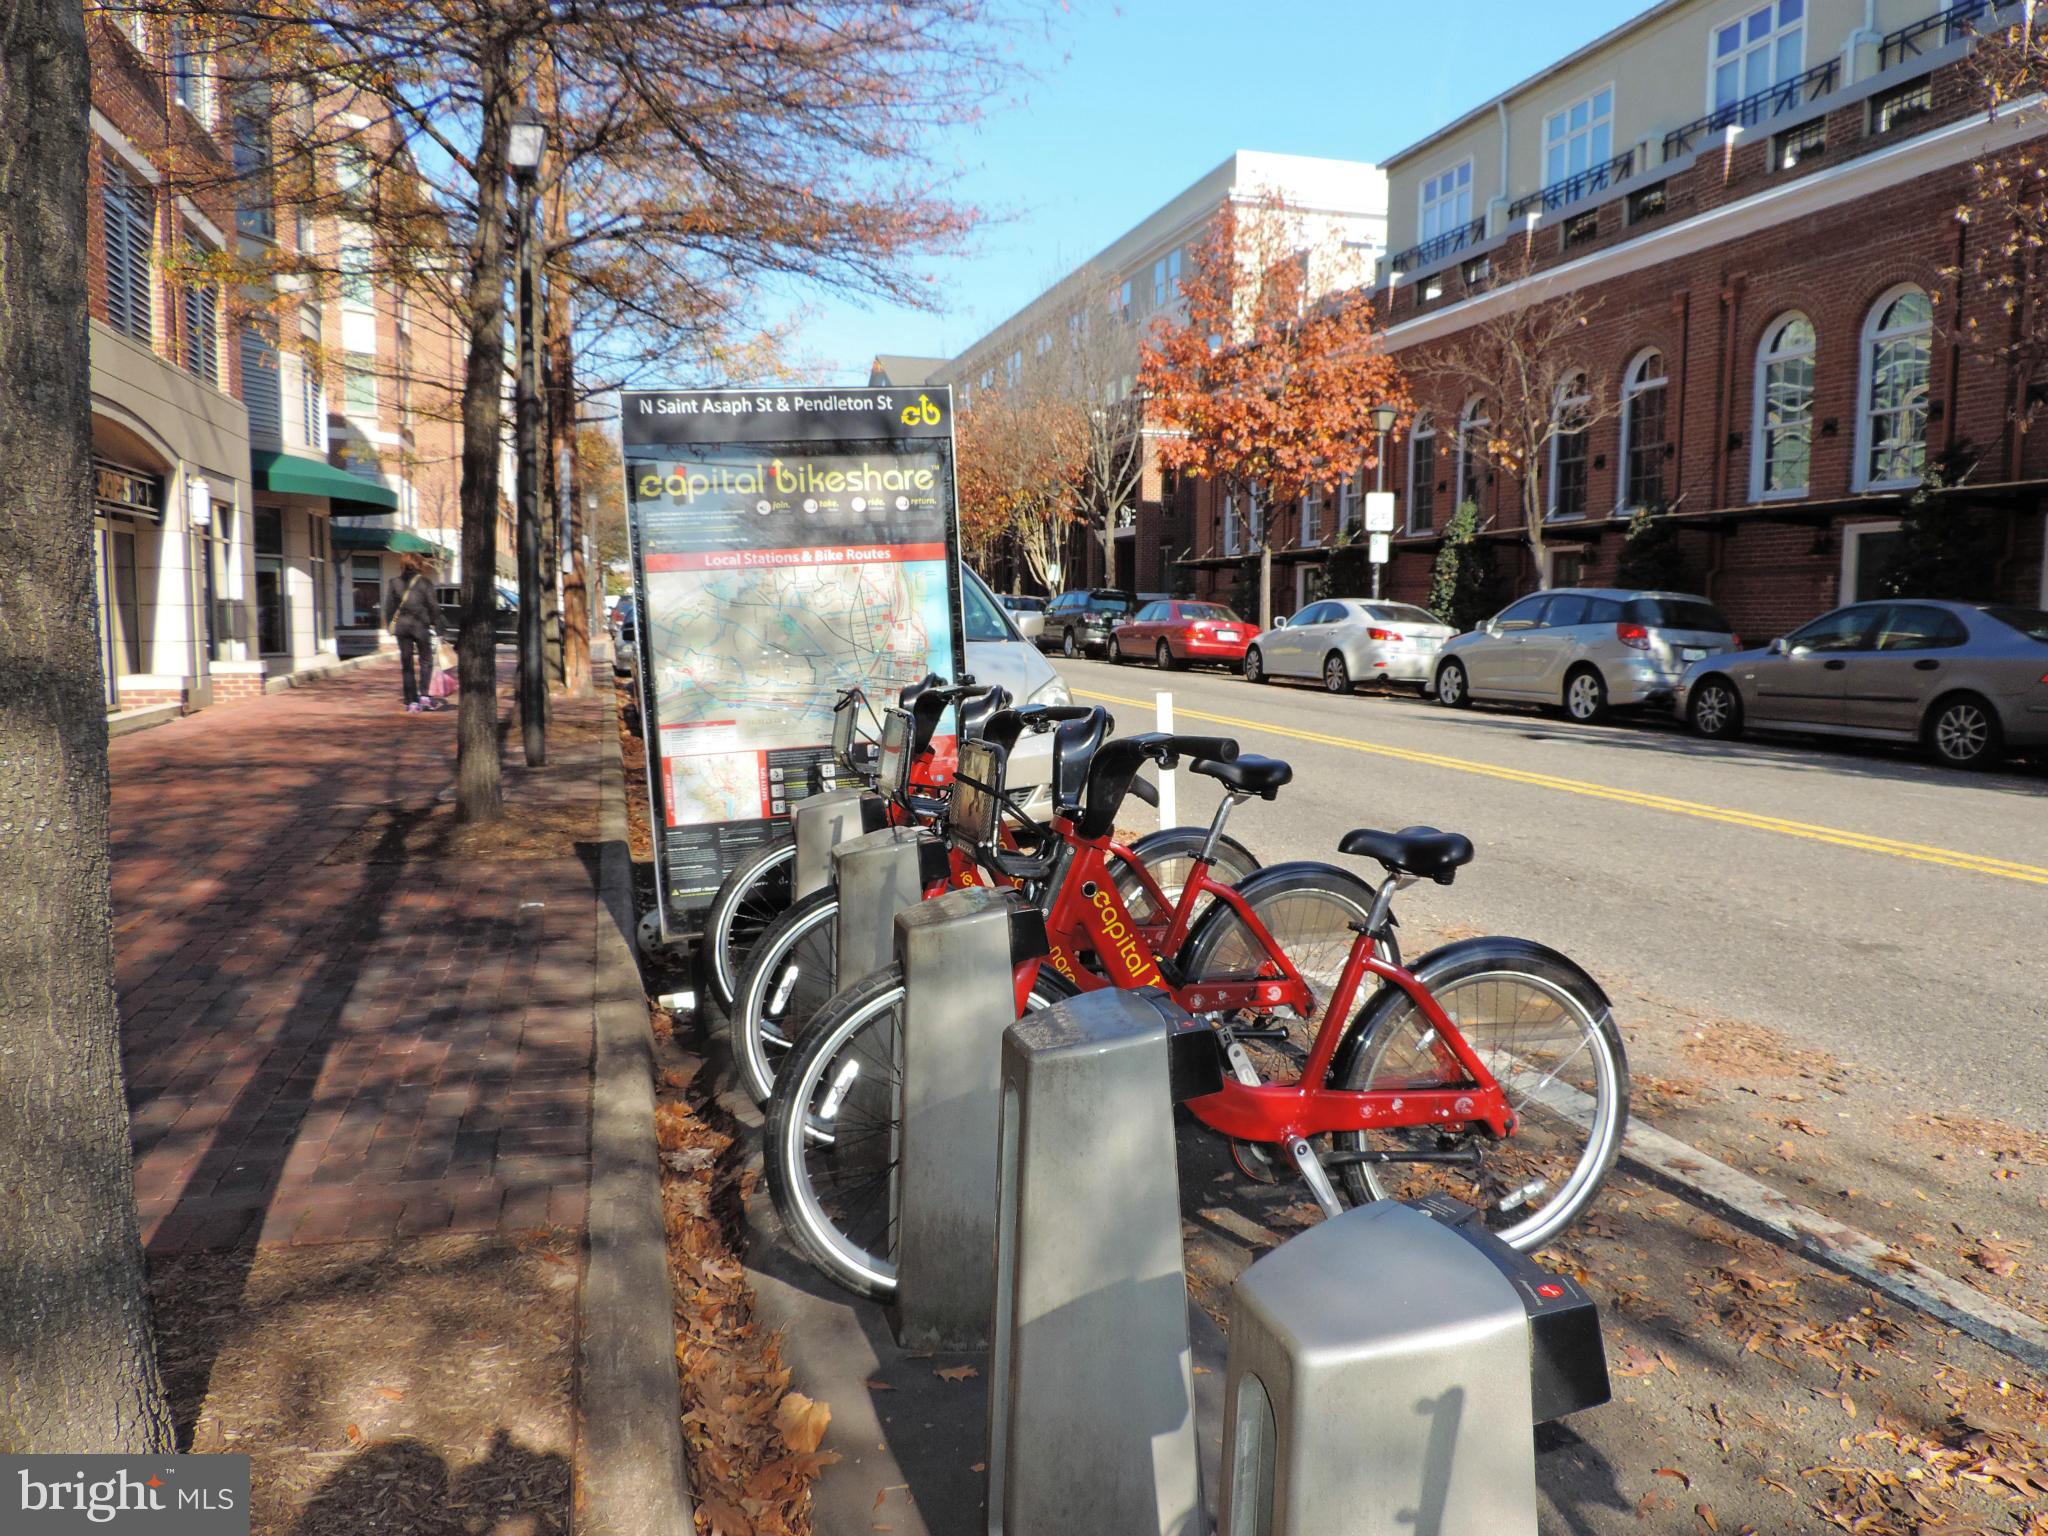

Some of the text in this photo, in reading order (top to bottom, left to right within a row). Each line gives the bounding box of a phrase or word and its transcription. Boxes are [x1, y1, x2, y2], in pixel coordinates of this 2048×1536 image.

[639, 394, 893, 417] N Saint Asaph St & Pendleton St
[639, 458, 935, 504] capital bikeshare
[704, 548, 891, 567] Local Stations & Bike Routes
[1093, 890, 1151, 978] capital
